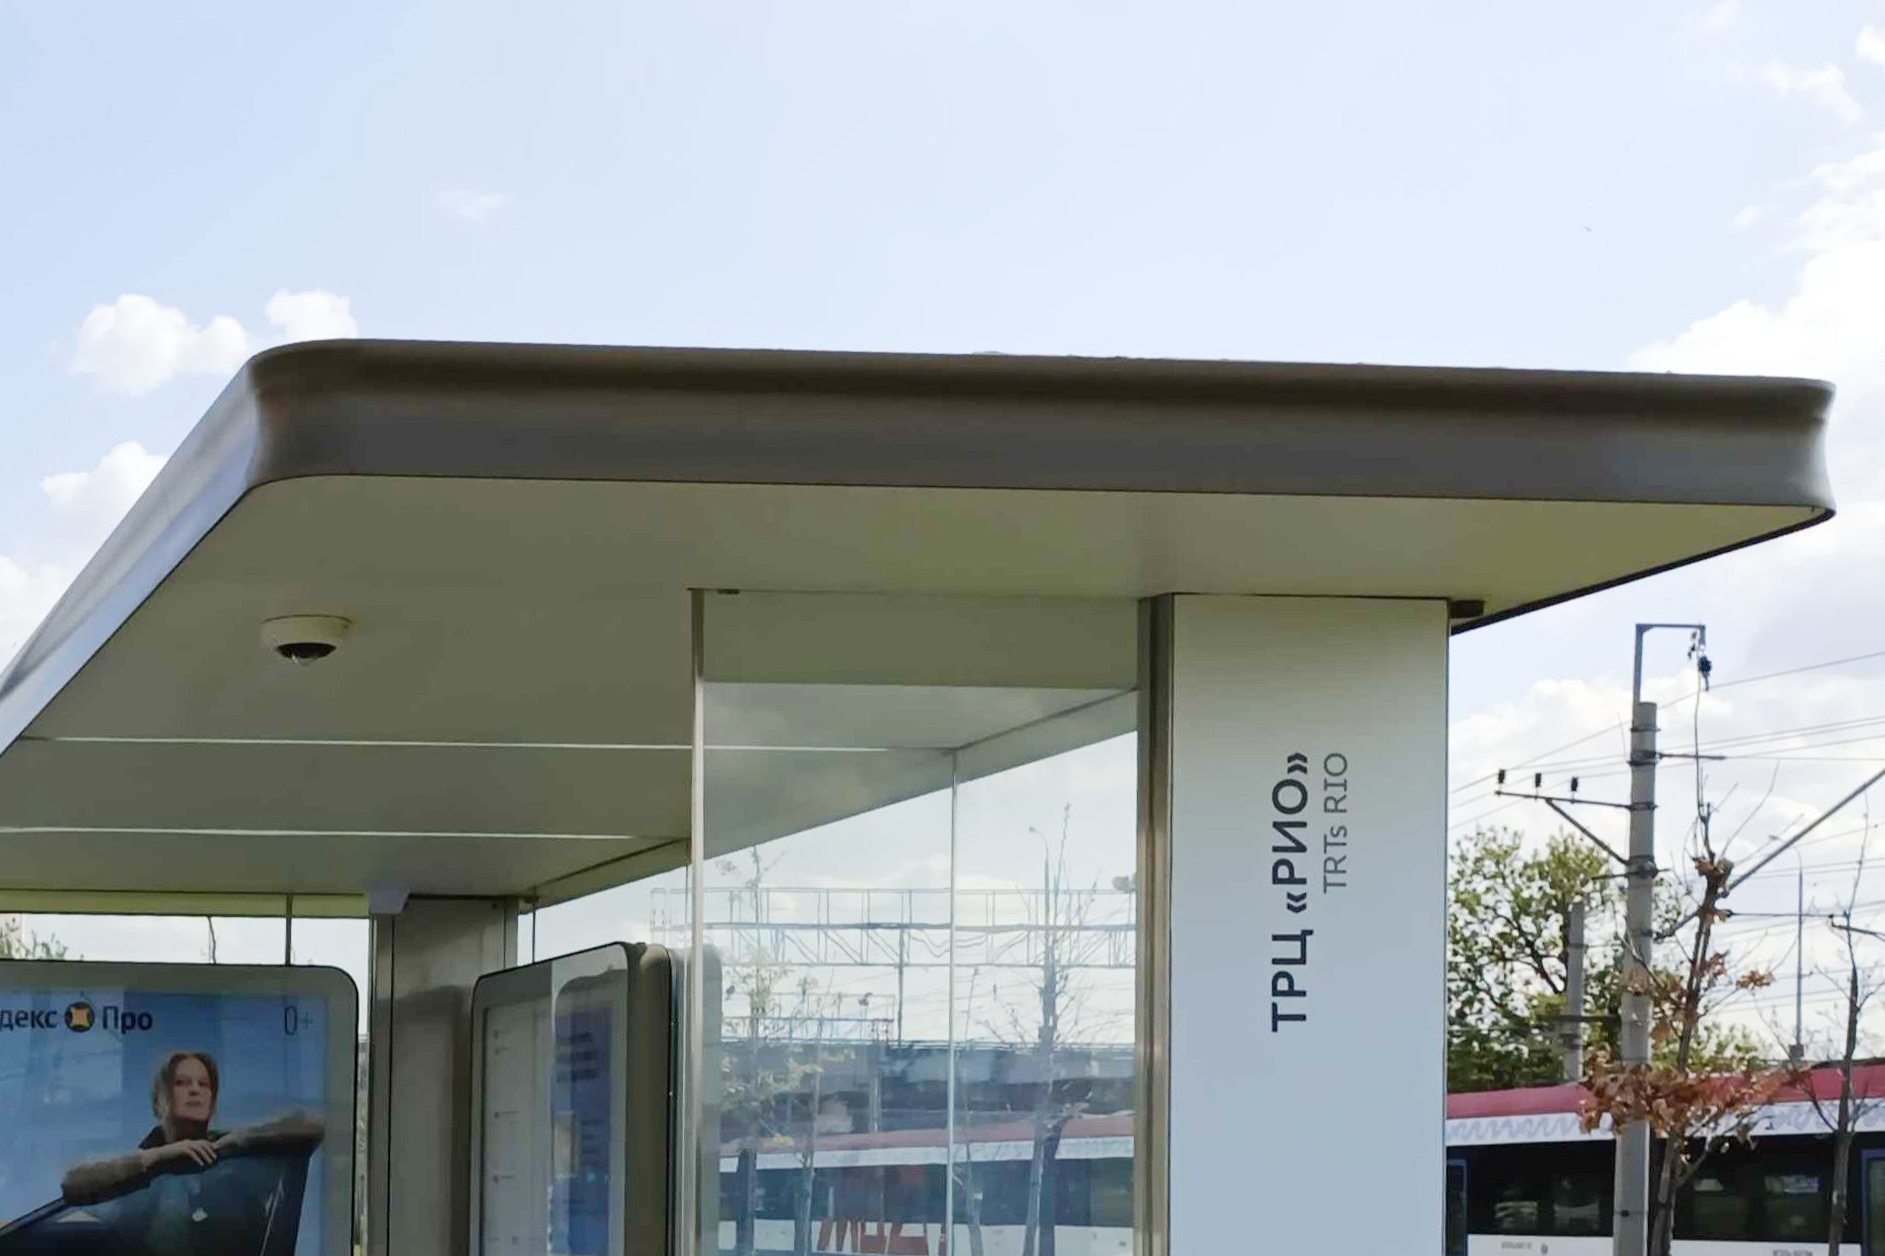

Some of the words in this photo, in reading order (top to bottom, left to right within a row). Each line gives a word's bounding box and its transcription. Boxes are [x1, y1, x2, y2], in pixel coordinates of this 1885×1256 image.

[1323, 752, 1349, 813] RIO
[1271, 752, 1309, 914] «РИО»
[1323, 825, 1348, 893] TRTs
[1271, 929, 1314, 1032] ТРЦ
[102, 1006, 154, 1034] Про
